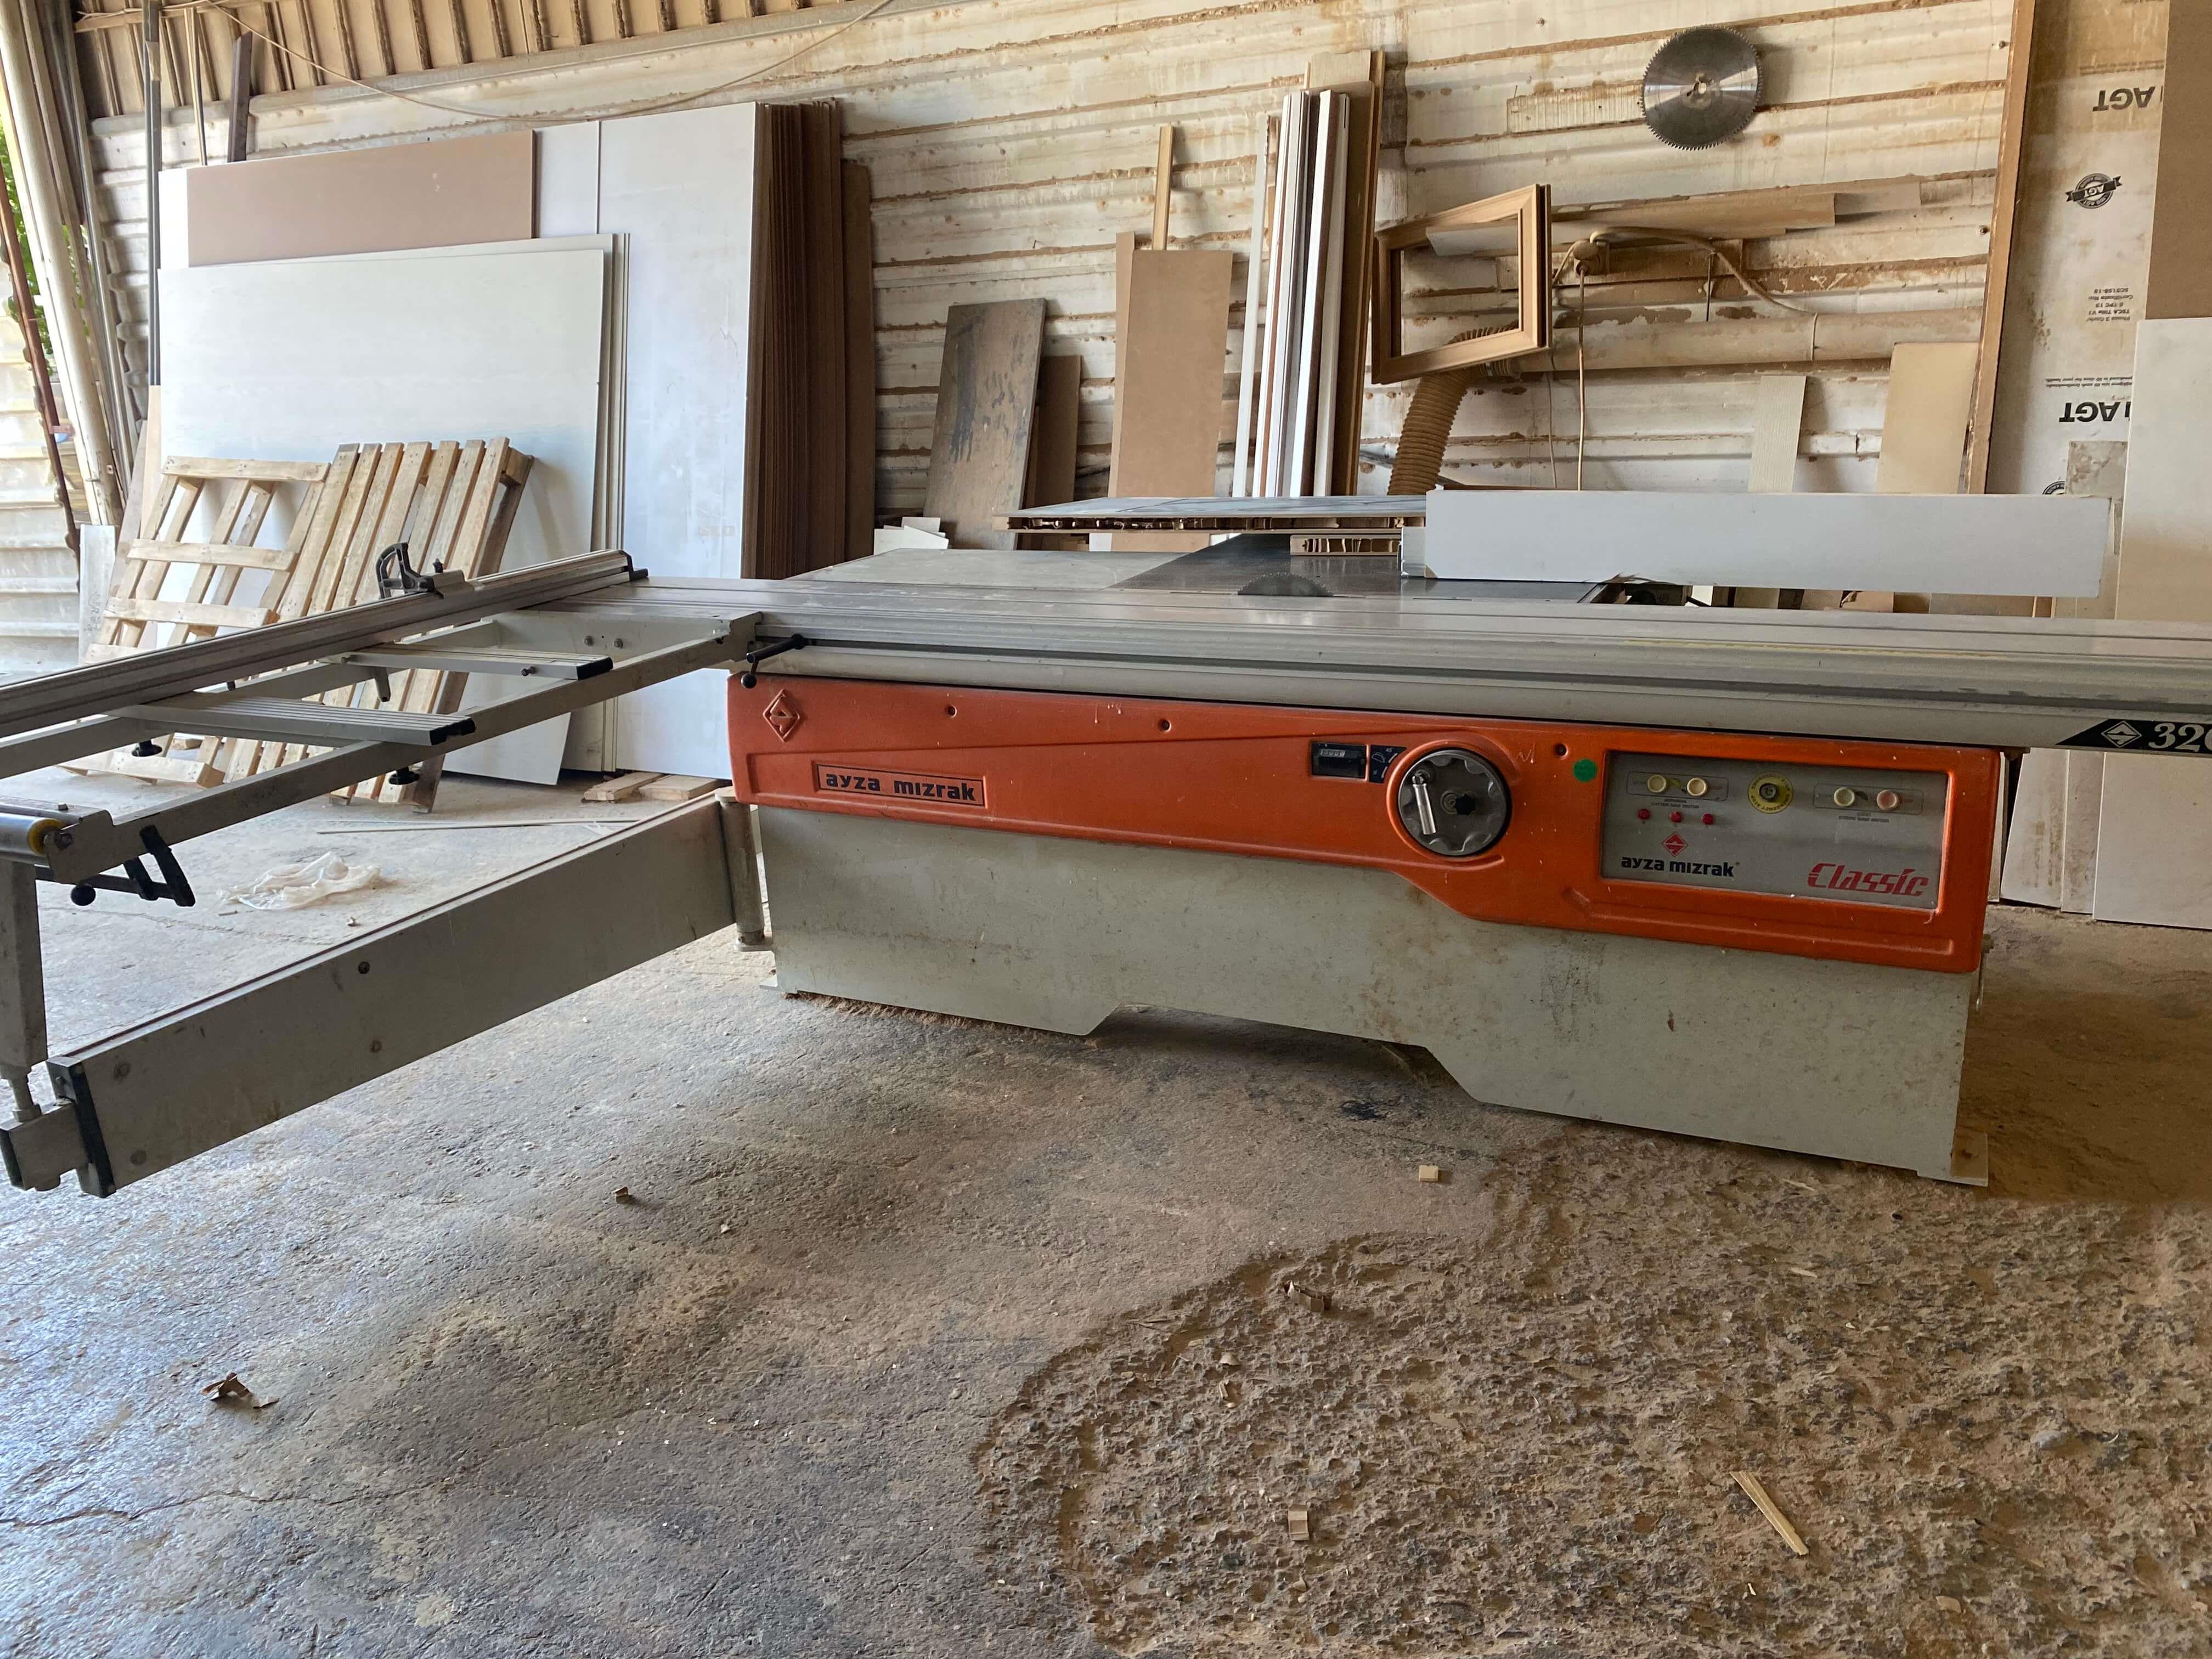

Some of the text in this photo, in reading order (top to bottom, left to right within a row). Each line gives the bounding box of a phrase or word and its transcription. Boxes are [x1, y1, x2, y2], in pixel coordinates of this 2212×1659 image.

[2092, 86, 2155, 111] AGT
[2084, 184, 2104, 198] AGT
[2058, 402, 2121, 422] AGT
[2148, 723, 2212, 752] 32
[826, 774, 881, 792] ayza
[1621, 856, 1665, 872] ayza
[1808, 862, 1929, 897] Classic
